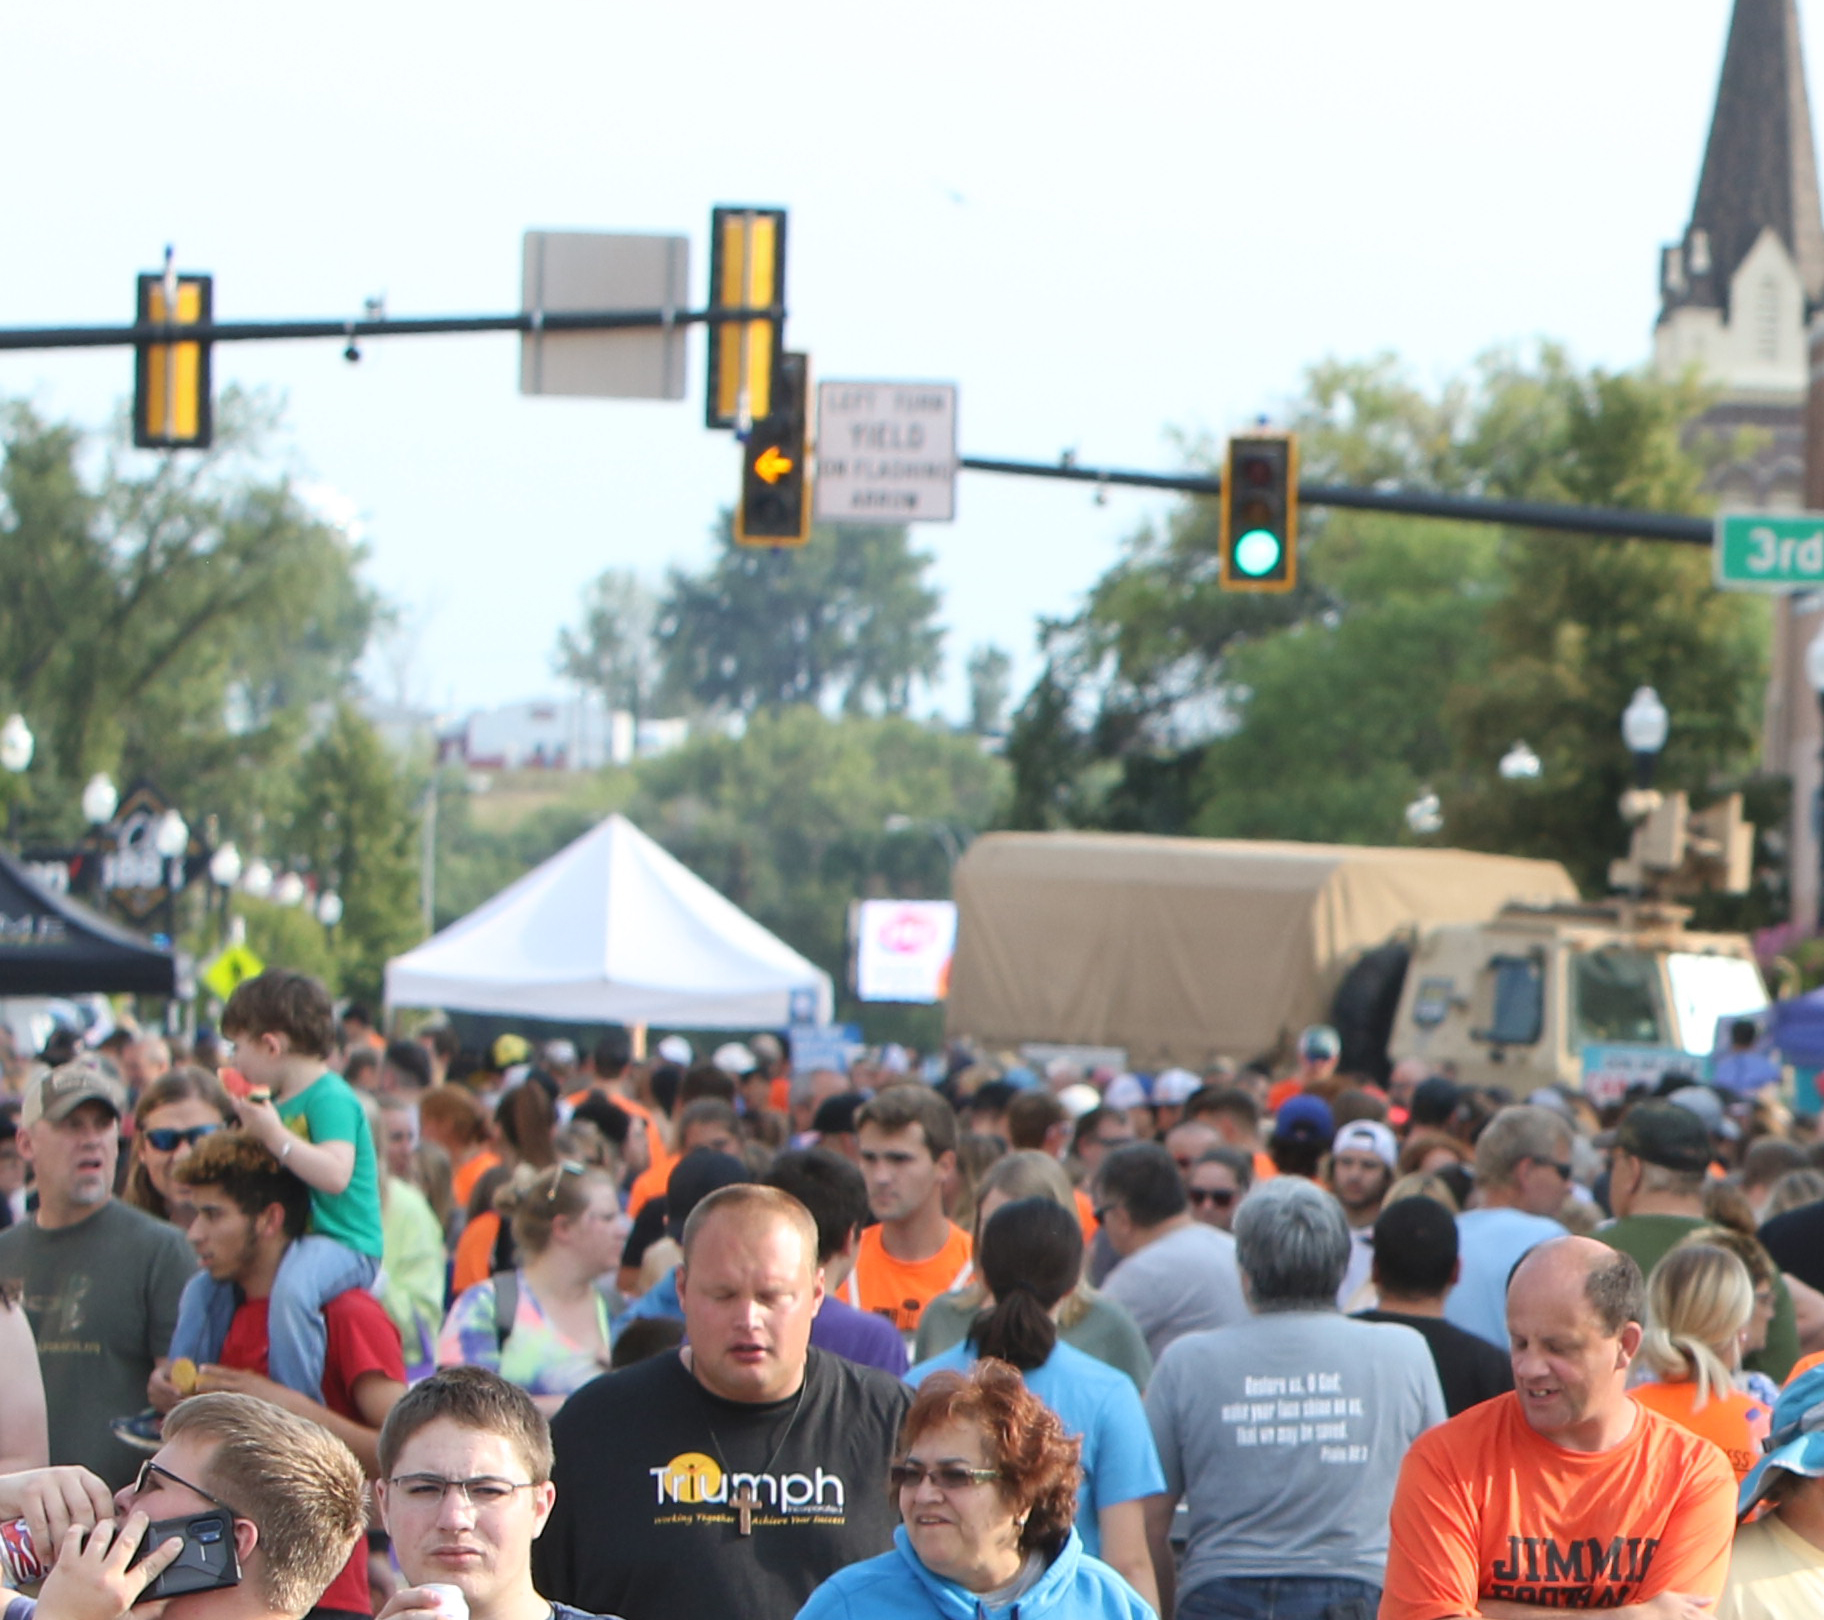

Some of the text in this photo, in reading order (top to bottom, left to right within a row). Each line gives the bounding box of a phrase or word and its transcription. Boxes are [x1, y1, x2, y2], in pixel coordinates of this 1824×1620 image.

[850, 421, 924, 450] YIELD
[1747, 526, 1824, 574] 3rd
[649, 1464, 845, 1514] Triumph
